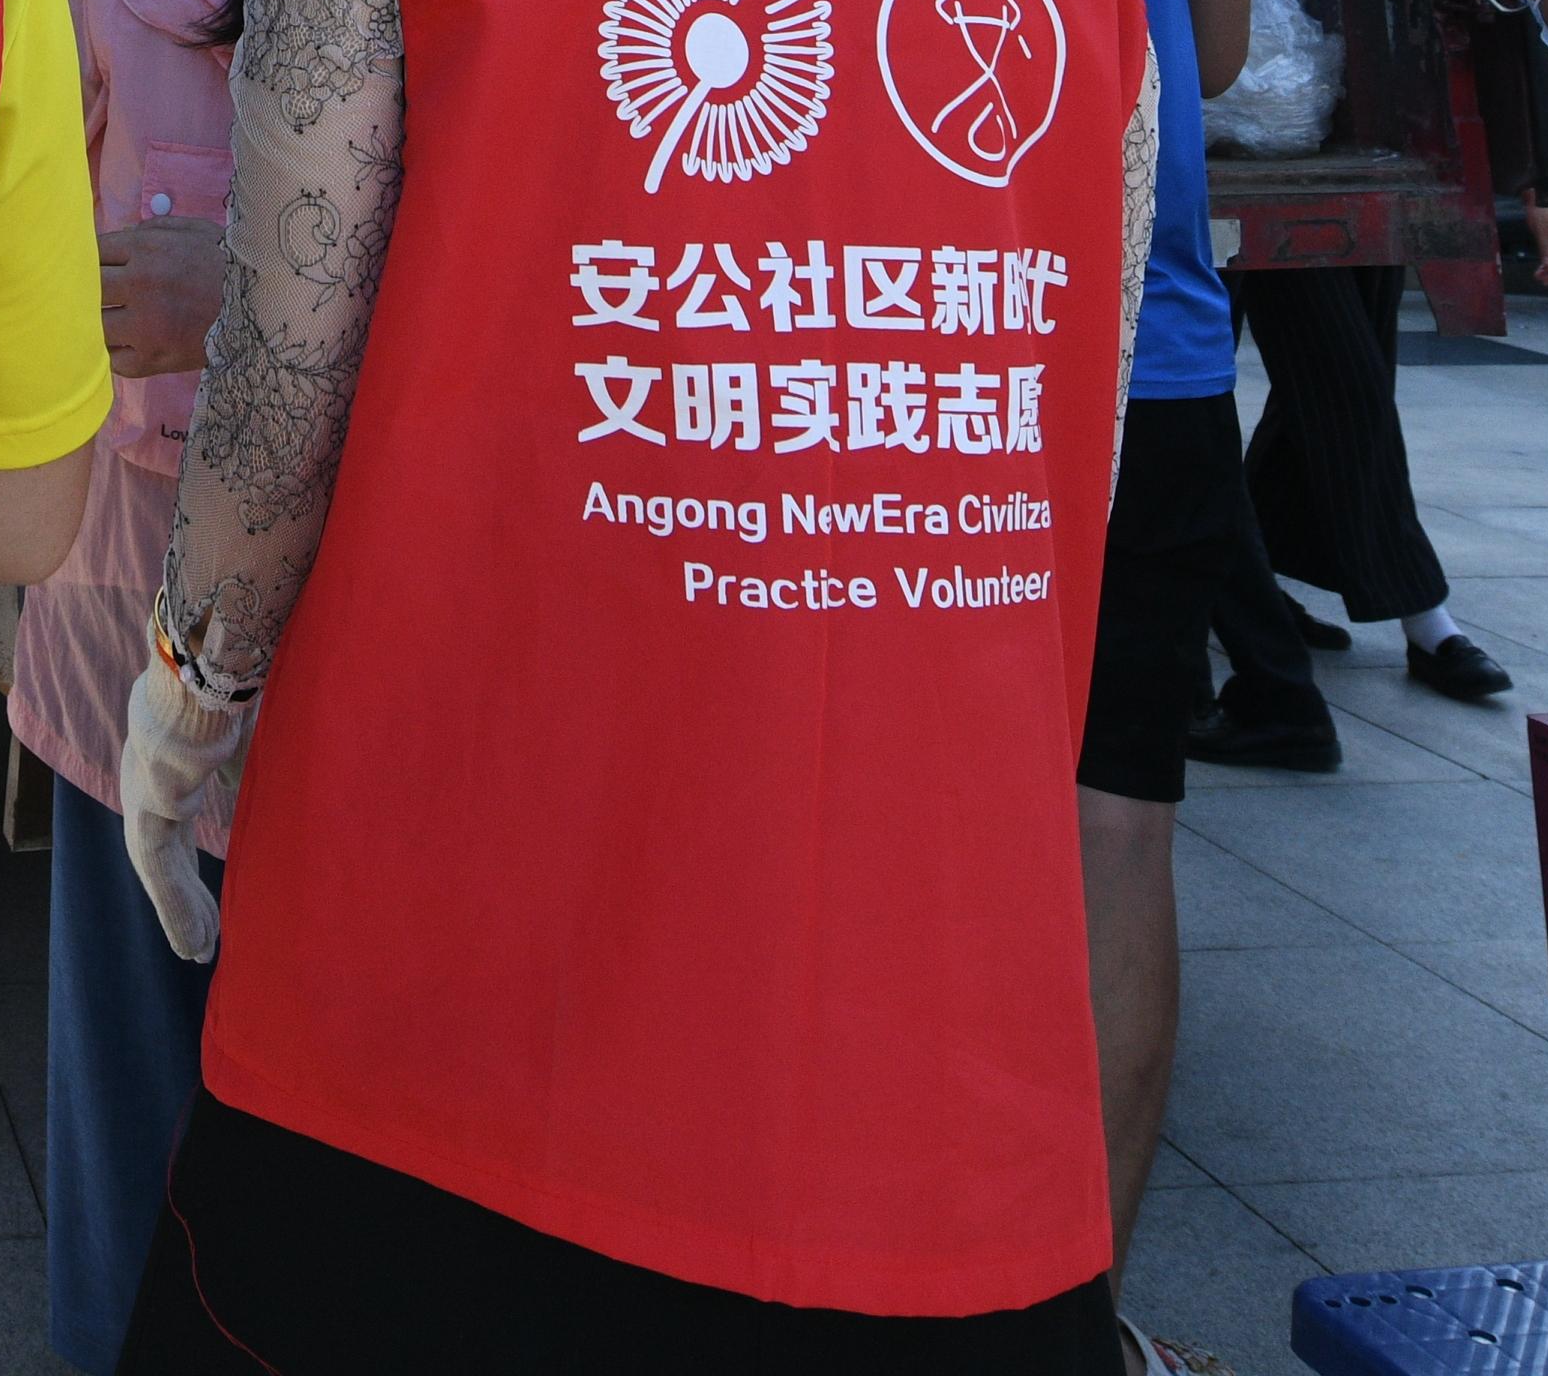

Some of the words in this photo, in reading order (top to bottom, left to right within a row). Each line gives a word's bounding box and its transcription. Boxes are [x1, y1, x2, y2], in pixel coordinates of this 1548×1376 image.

[581, 481, 768, 544] Angong
[781, 491, 950, 537] NewEra
[682, 560, 879, 611] Practice
[893, 566, 1052, 610] Volunteer
